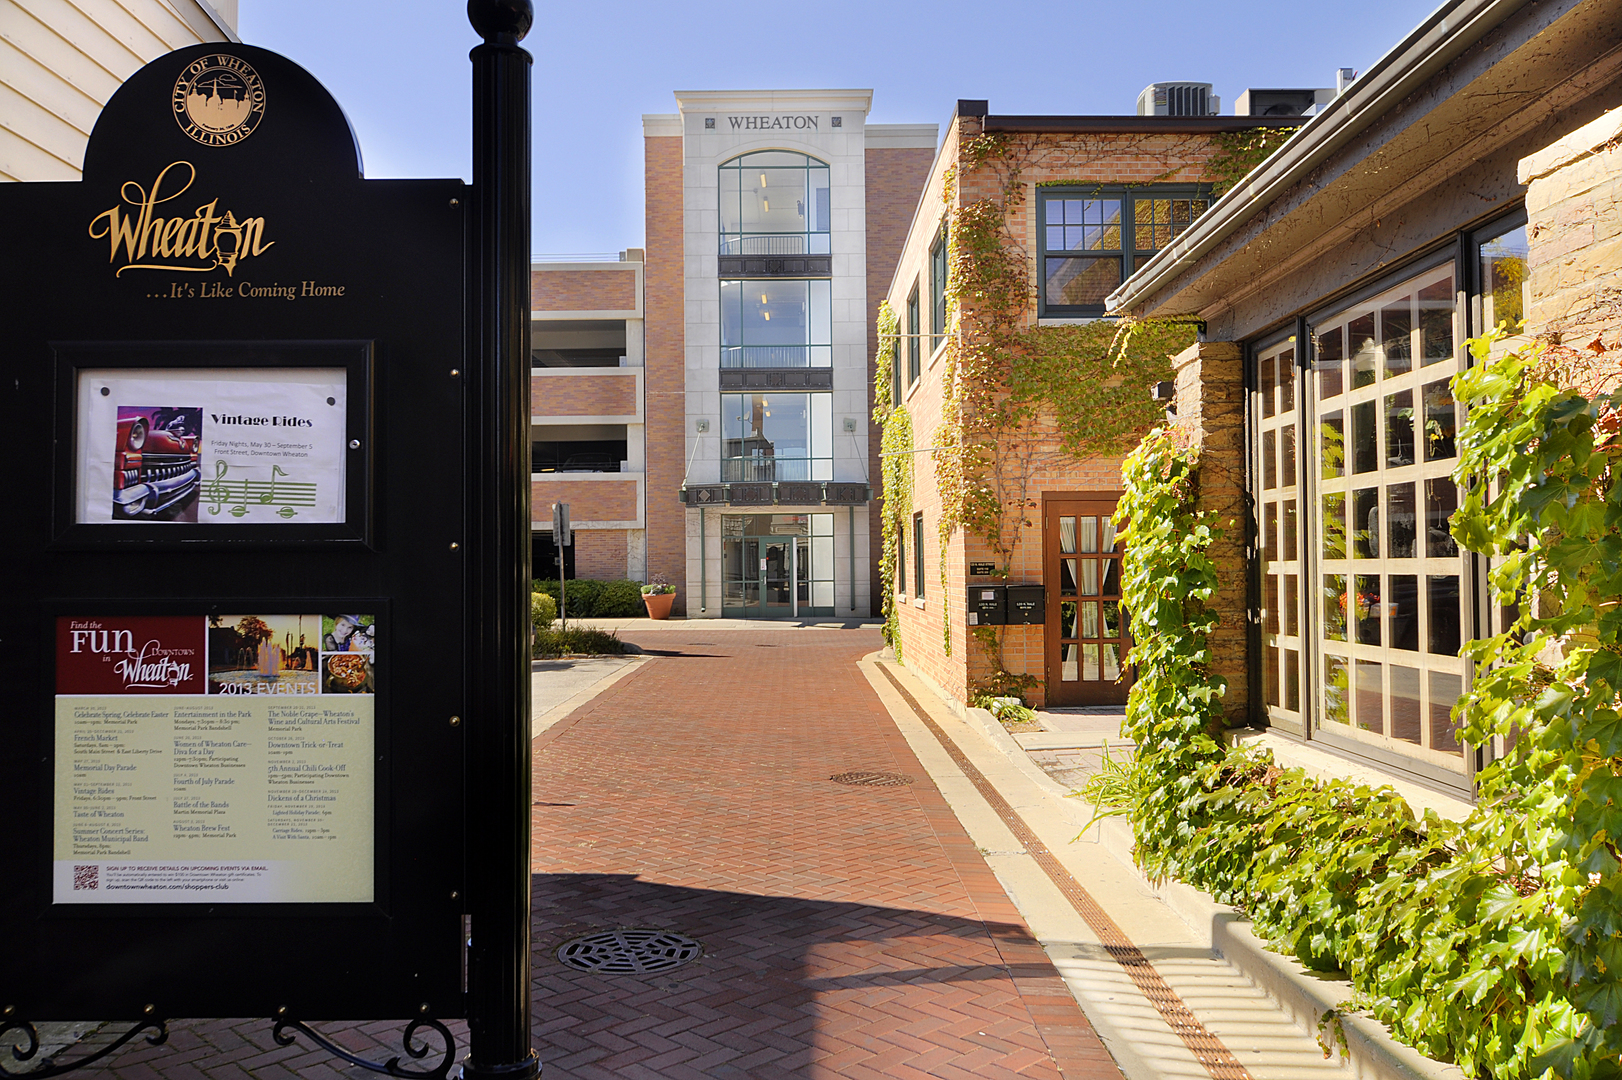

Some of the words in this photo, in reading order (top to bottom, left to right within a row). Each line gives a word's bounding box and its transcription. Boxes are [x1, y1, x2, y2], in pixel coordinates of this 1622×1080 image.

[174, 76, 189, 113] CITY
[190, 58, 208, 74] OF
[217, 56, 264, 113] WHEATON
[728, 116, 819, 130] WHEATON
[185, 123, 250, 144] ILLINOIS
[88, 160, 275, 278] Wheaton
[200, 282, 233, 298] Like
[238, 282, 296, 300] Coming
[300, 281, 345, 297] Home
[211, 414, 268, 426] Vintage
[272, 416, 313, 428] Rides
[70, 621, 88, 629] Find
[90, 621, 102, 629] the
[70, 630, 137, 654] Fun
[114, 640, 194, 690] Wheaton
[220, 682, 252, 694] 2013
[258, 682, 316, 694] EVENTS
[203, 748, 215, 756] Day
[104, 764, 115, 773] Day
[268, 765, 278, 773] 5th
[201, 778, 213, 787] July
[102, 835, 132, 844] Municipal
